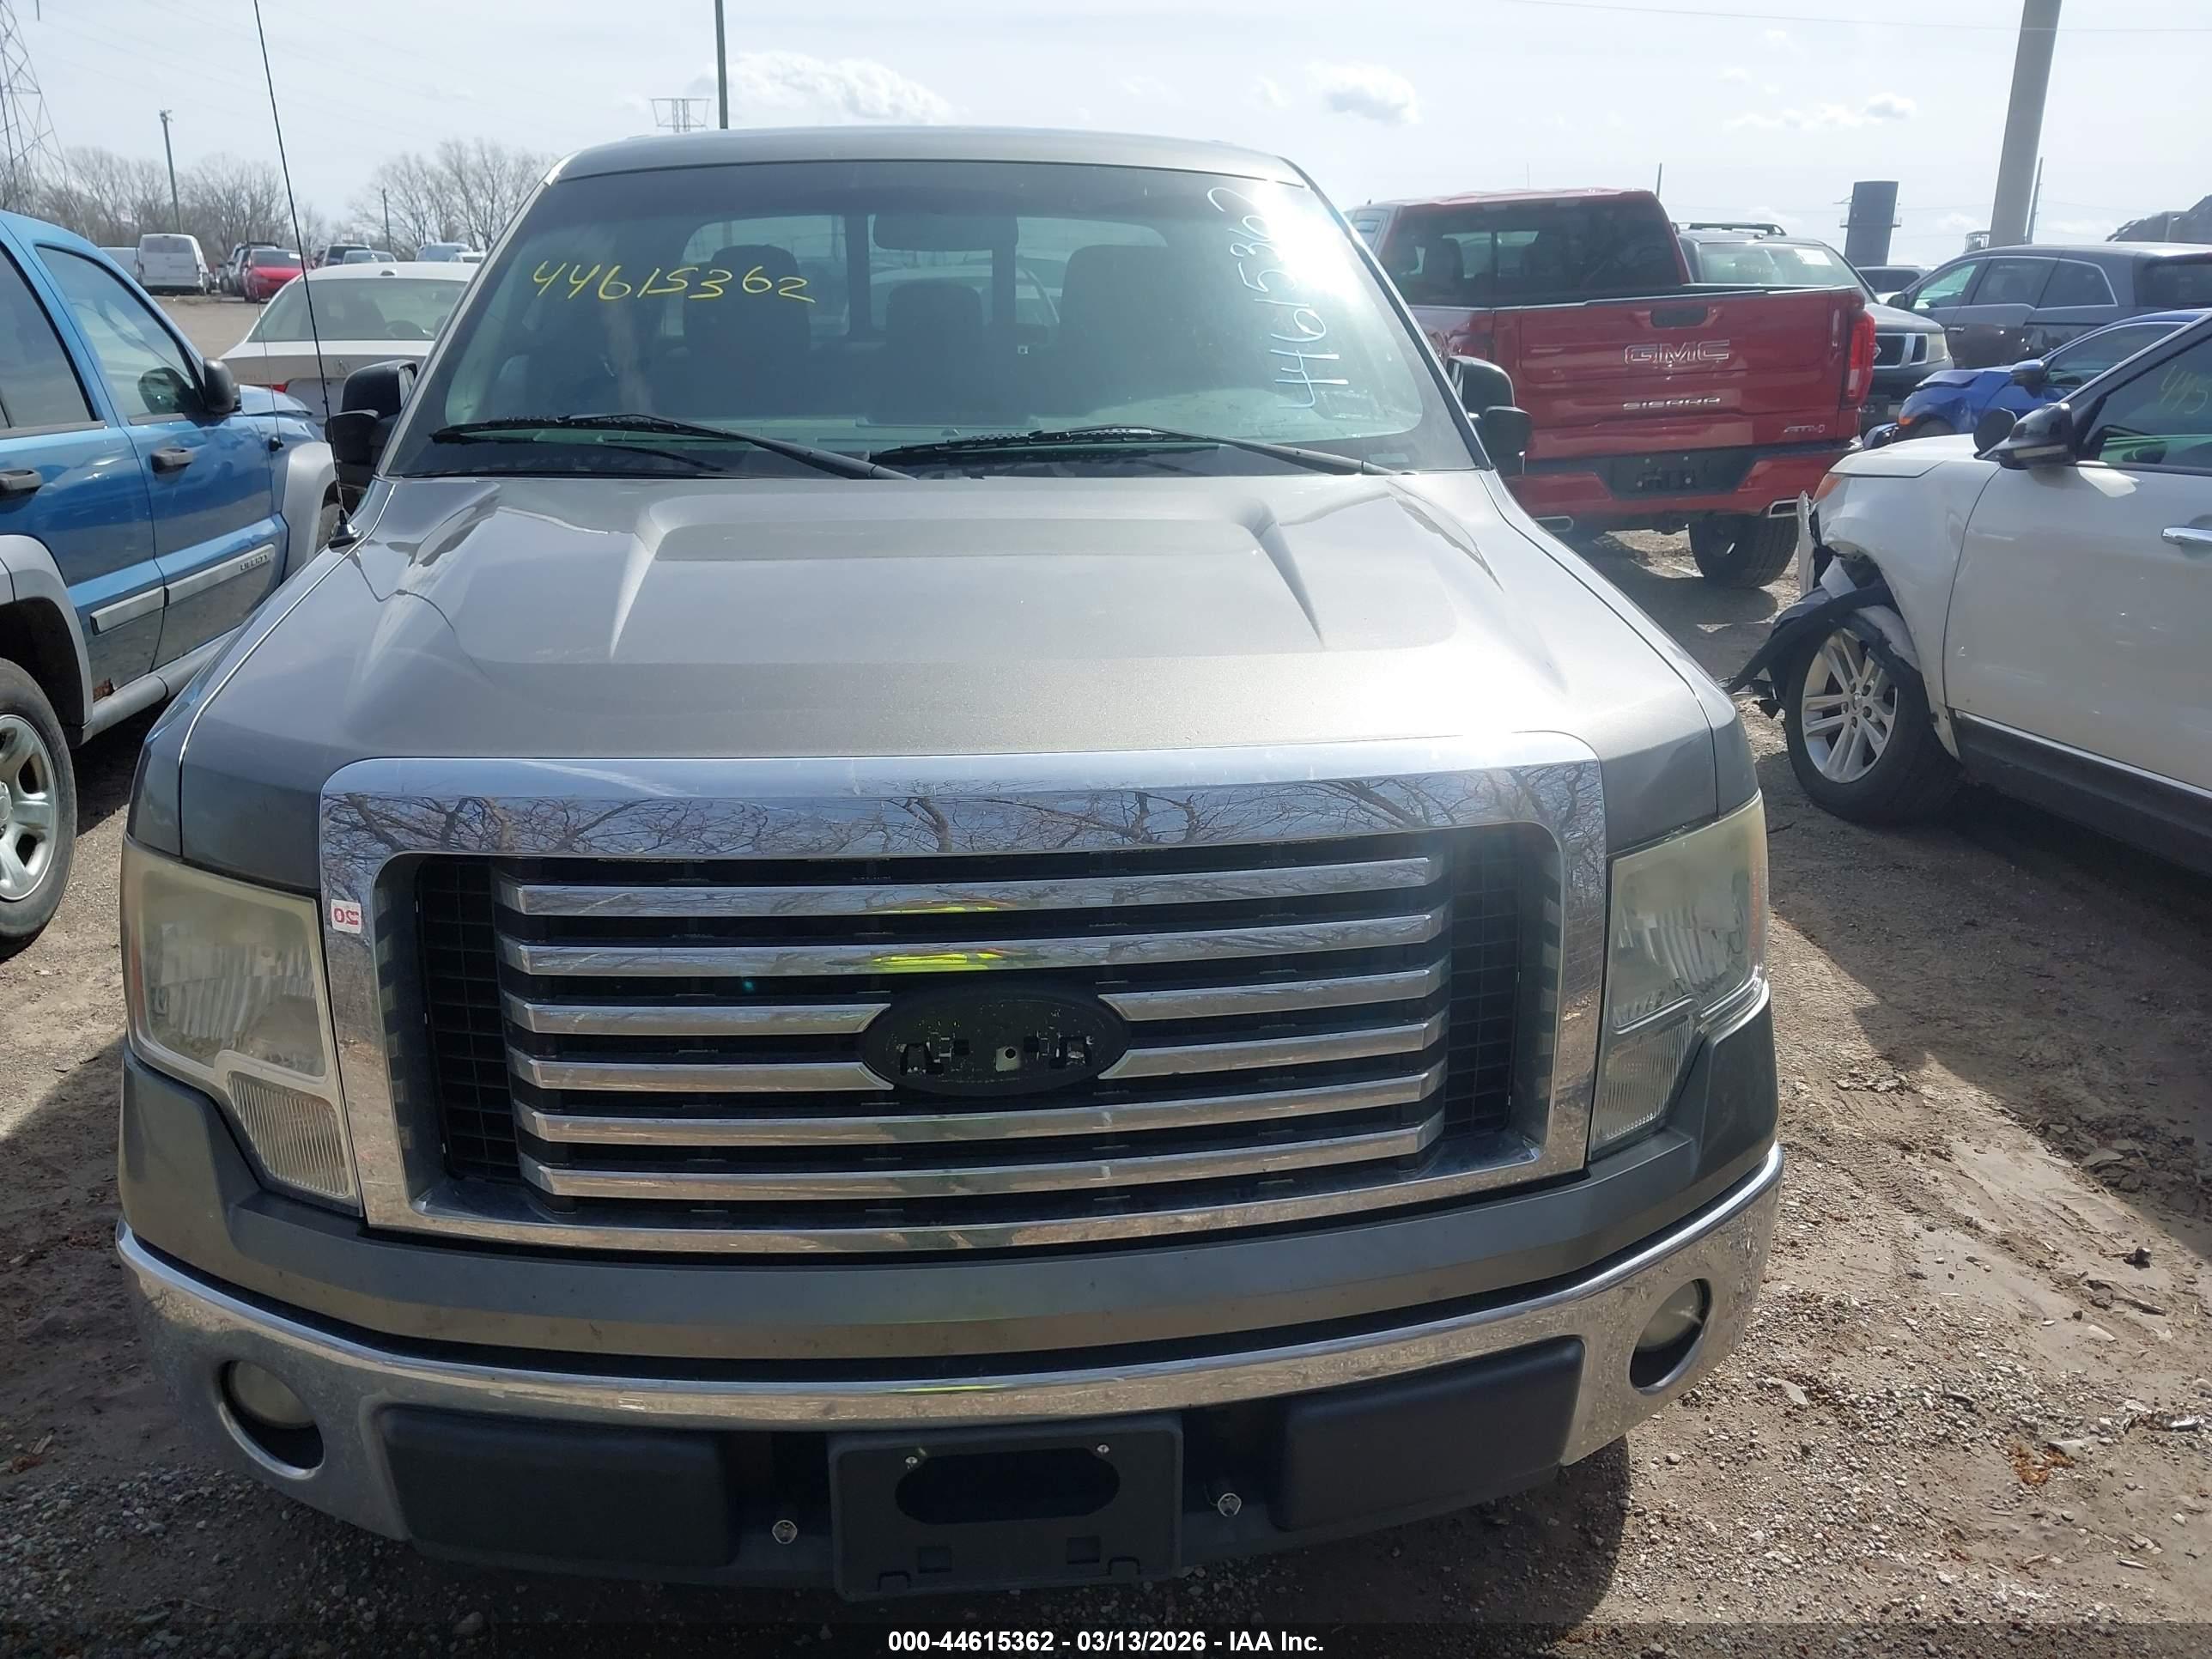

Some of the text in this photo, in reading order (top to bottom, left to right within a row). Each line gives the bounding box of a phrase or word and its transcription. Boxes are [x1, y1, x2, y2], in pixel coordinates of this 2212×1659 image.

[532, 259, 817, 304] 44615362
[1624, 338, 1730, 365] GMC
[1622, 398, 1721, 410] SIERRA
